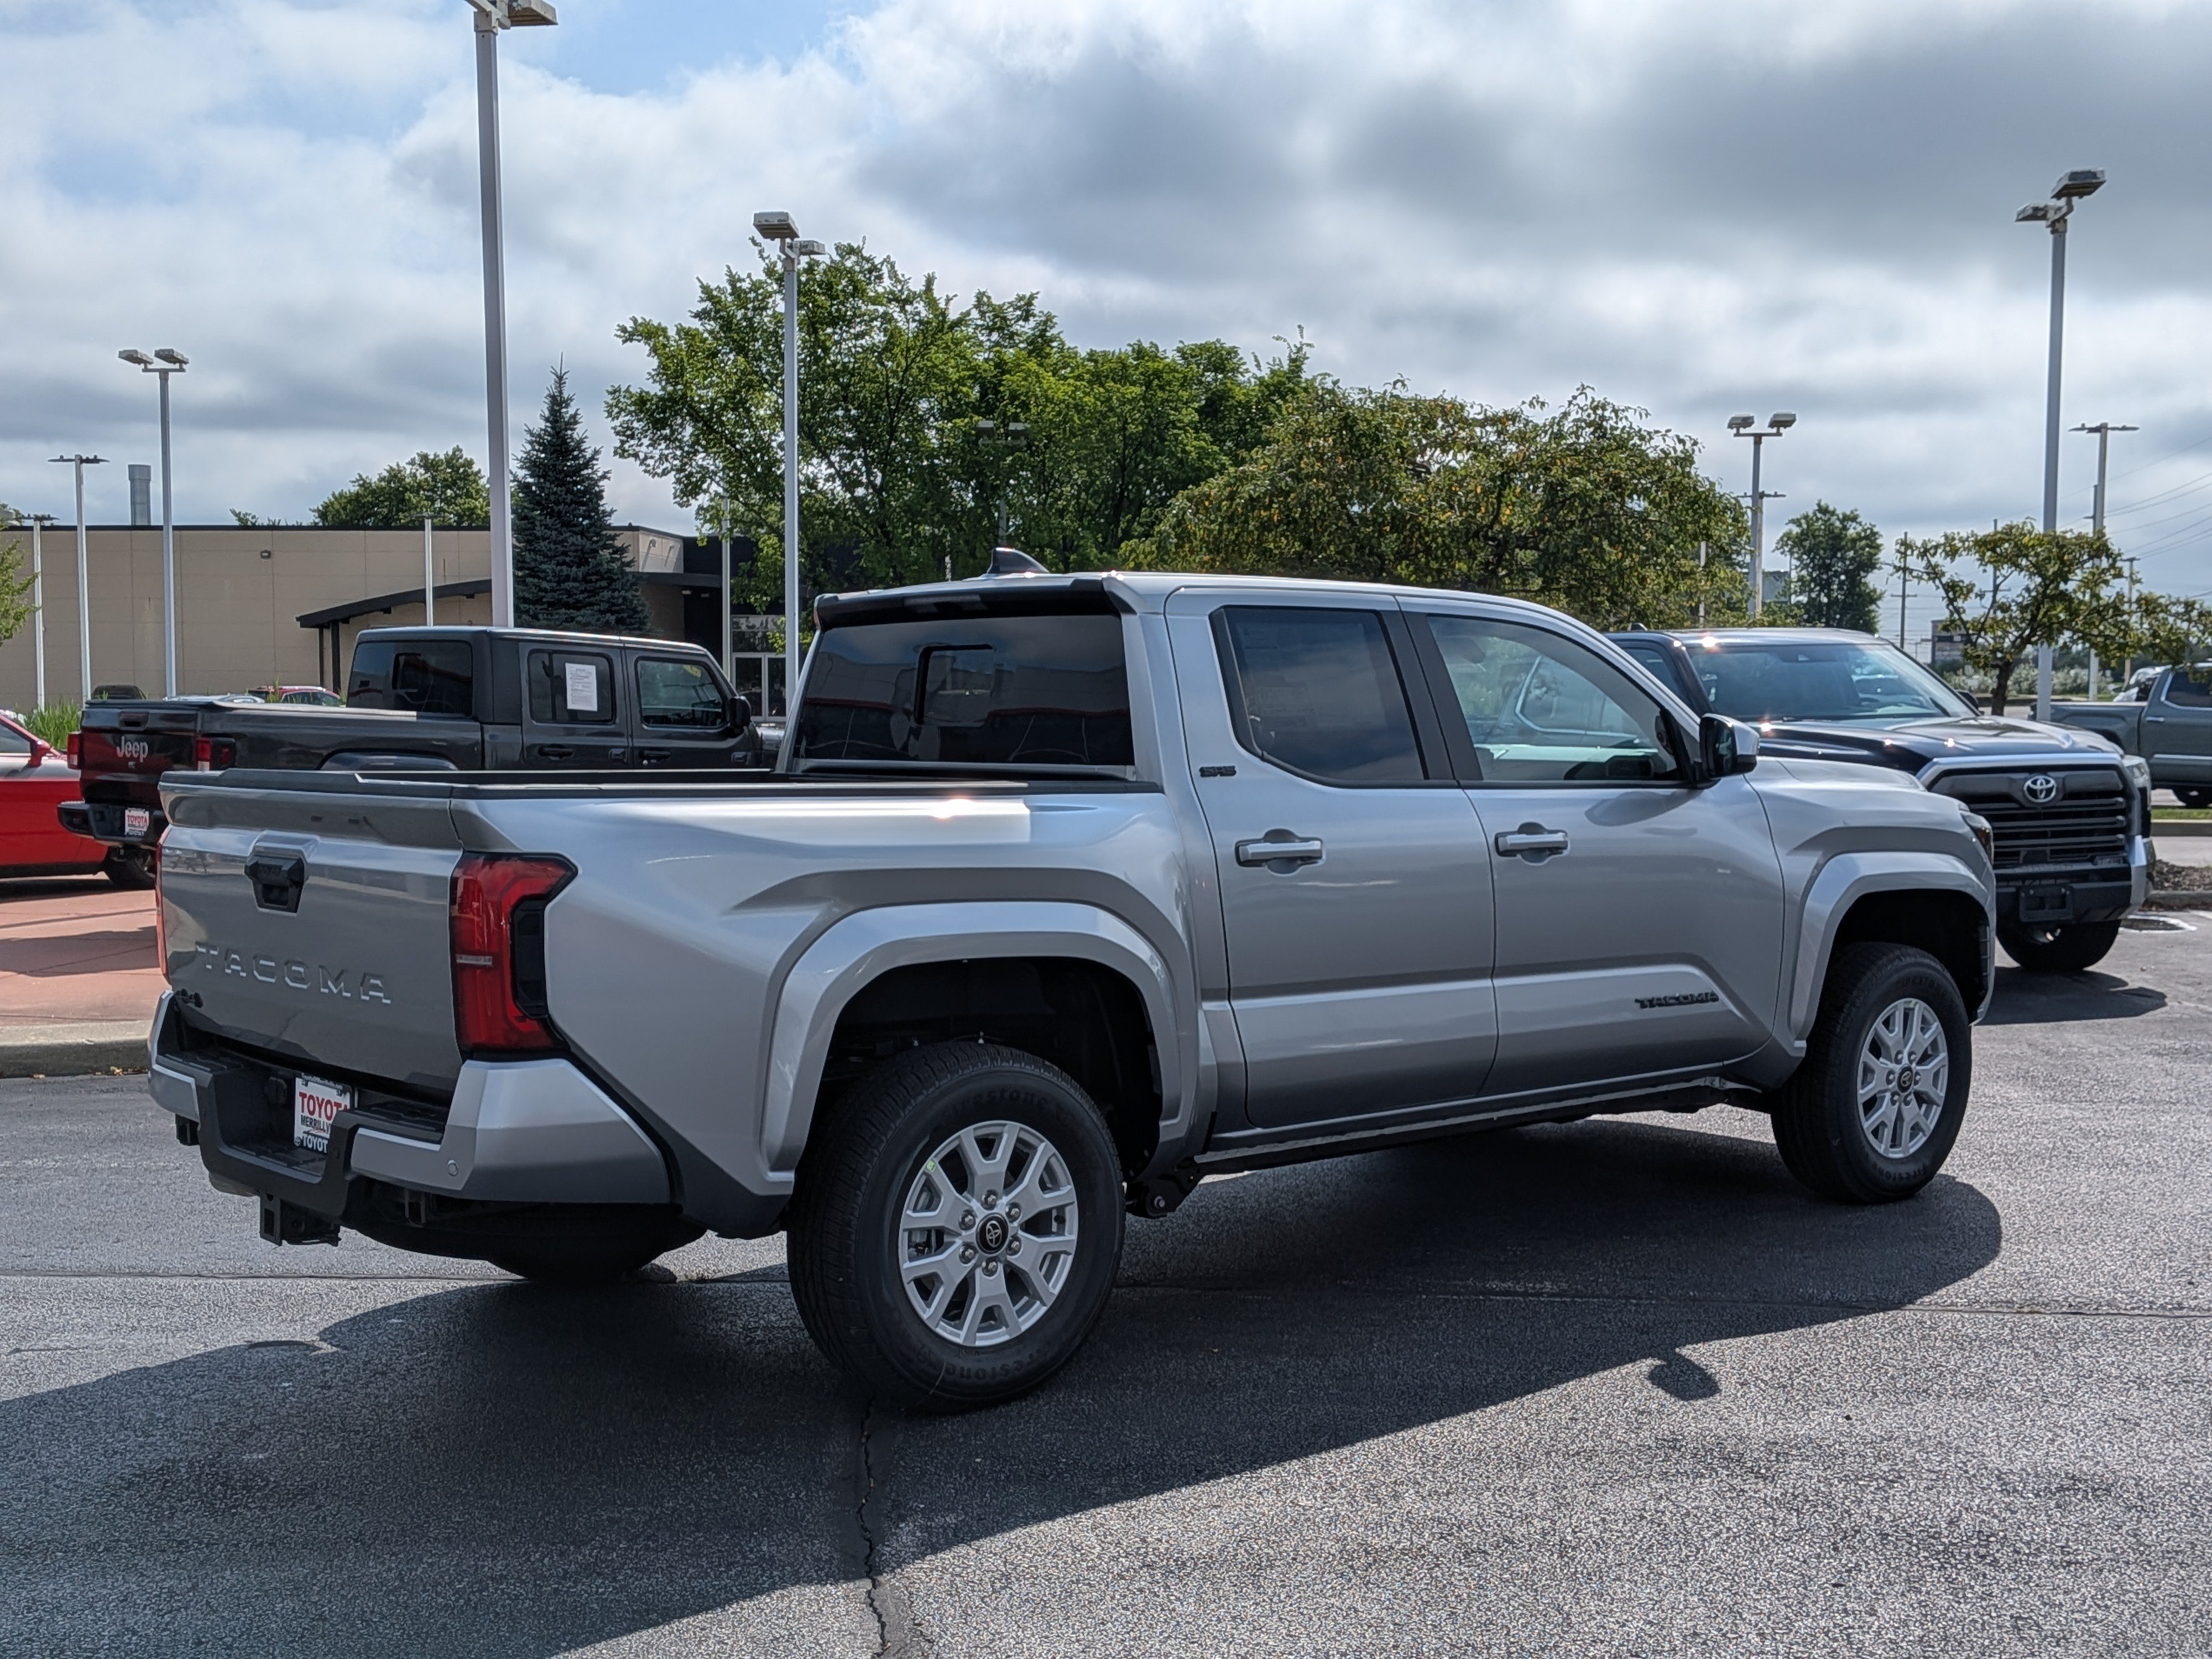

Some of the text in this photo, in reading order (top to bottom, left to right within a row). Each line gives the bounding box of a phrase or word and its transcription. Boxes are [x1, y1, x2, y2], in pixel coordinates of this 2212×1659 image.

[116, 735, 148, 763] Jeep
[127, 815, 147, 825] TOYOTA
[196, 941, 392, 1004] TACOMA
[1635, 990, 1719, 1009] TACOMA
[299, 1092, 348, 1121] TOYOT
[302, 1134, 328, 1154] TOYOT
